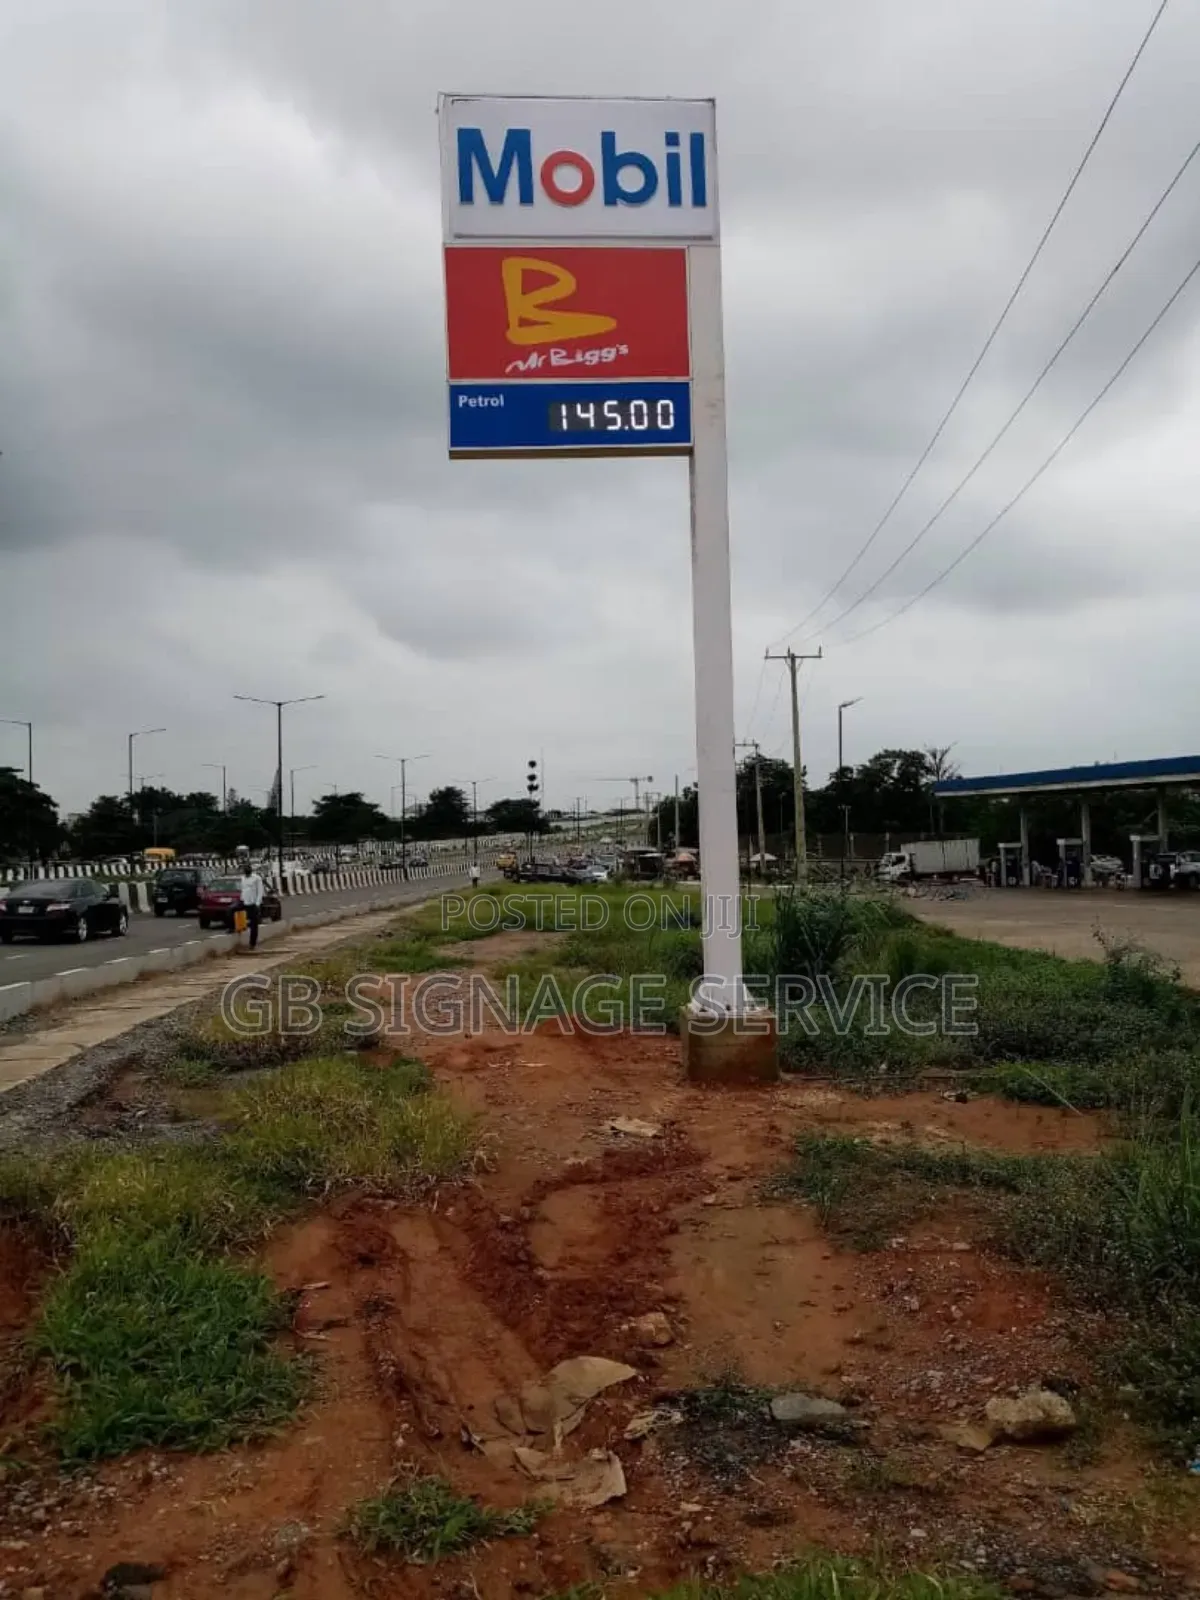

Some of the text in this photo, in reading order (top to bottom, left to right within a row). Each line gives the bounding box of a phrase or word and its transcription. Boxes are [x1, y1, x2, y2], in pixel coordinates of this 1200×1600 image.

[457, 127, 707, 208] Mobil
[505, 344, 629, 373] Mr Bigg's
[458, 394, 505, 409] Petrol
[558, 400, 675, 431] 145.00
